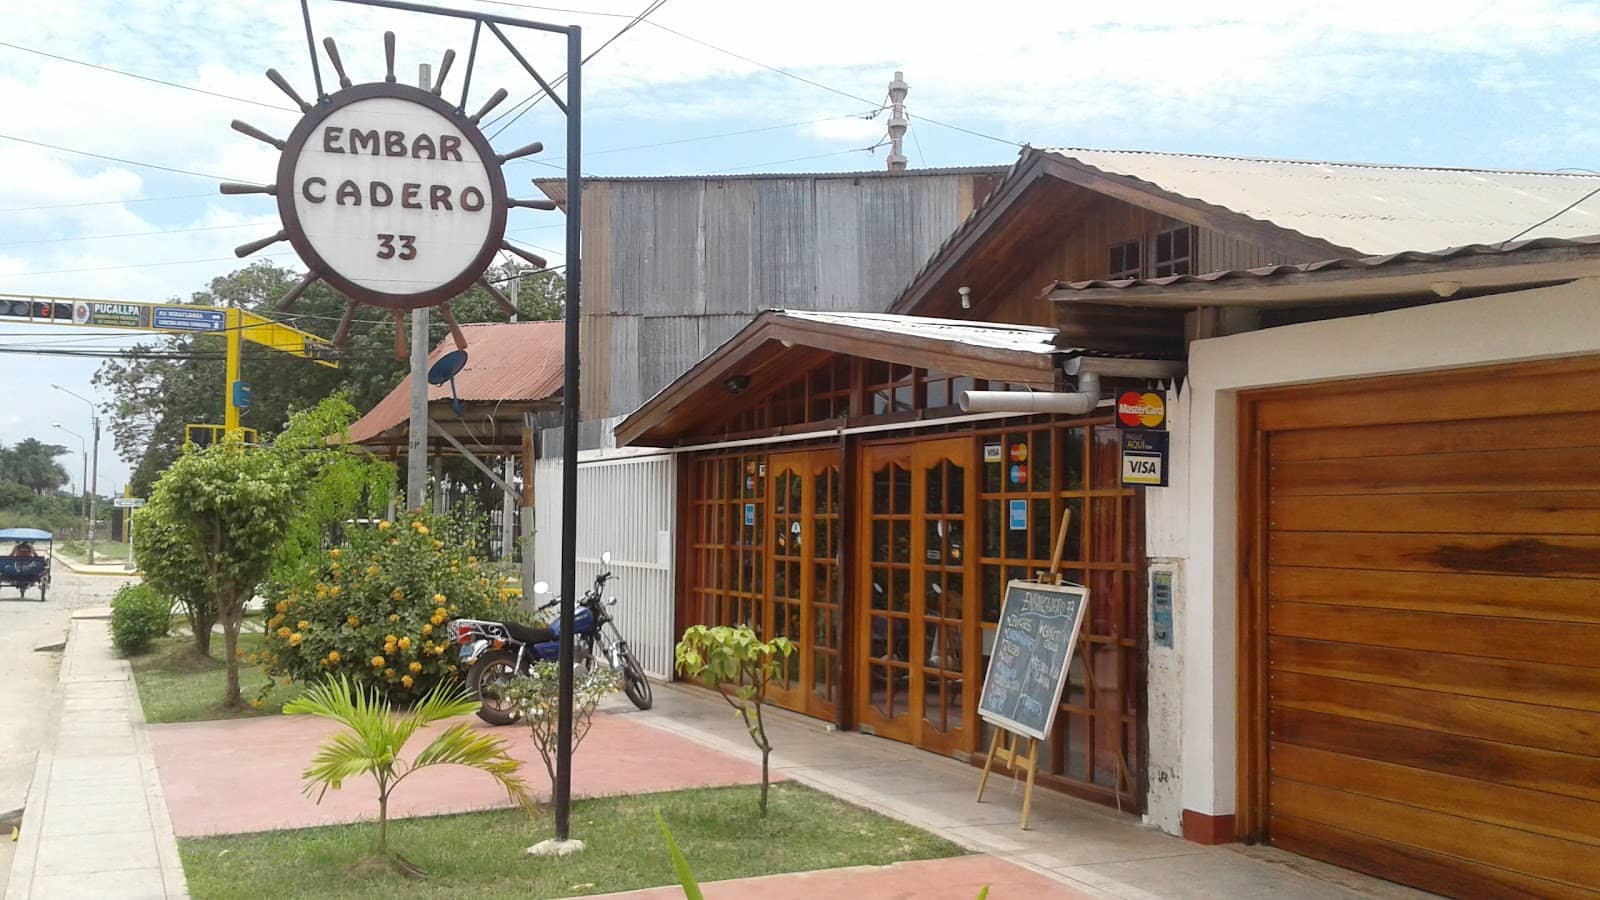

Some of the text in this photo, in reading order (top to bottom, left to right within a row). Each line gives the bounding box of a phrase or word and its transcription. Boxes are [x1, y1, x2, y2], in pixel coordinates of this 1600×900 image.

[323, 126, 463, 162] EMBAR
[302, 176, 485, 212] CADERO
[376, 233, 417, 260] 33
[94, 303, 140, 315] PUCALLPA
[986, 447, 1000, 457] VISA
[1128, 460, 1156, 474] VISA
